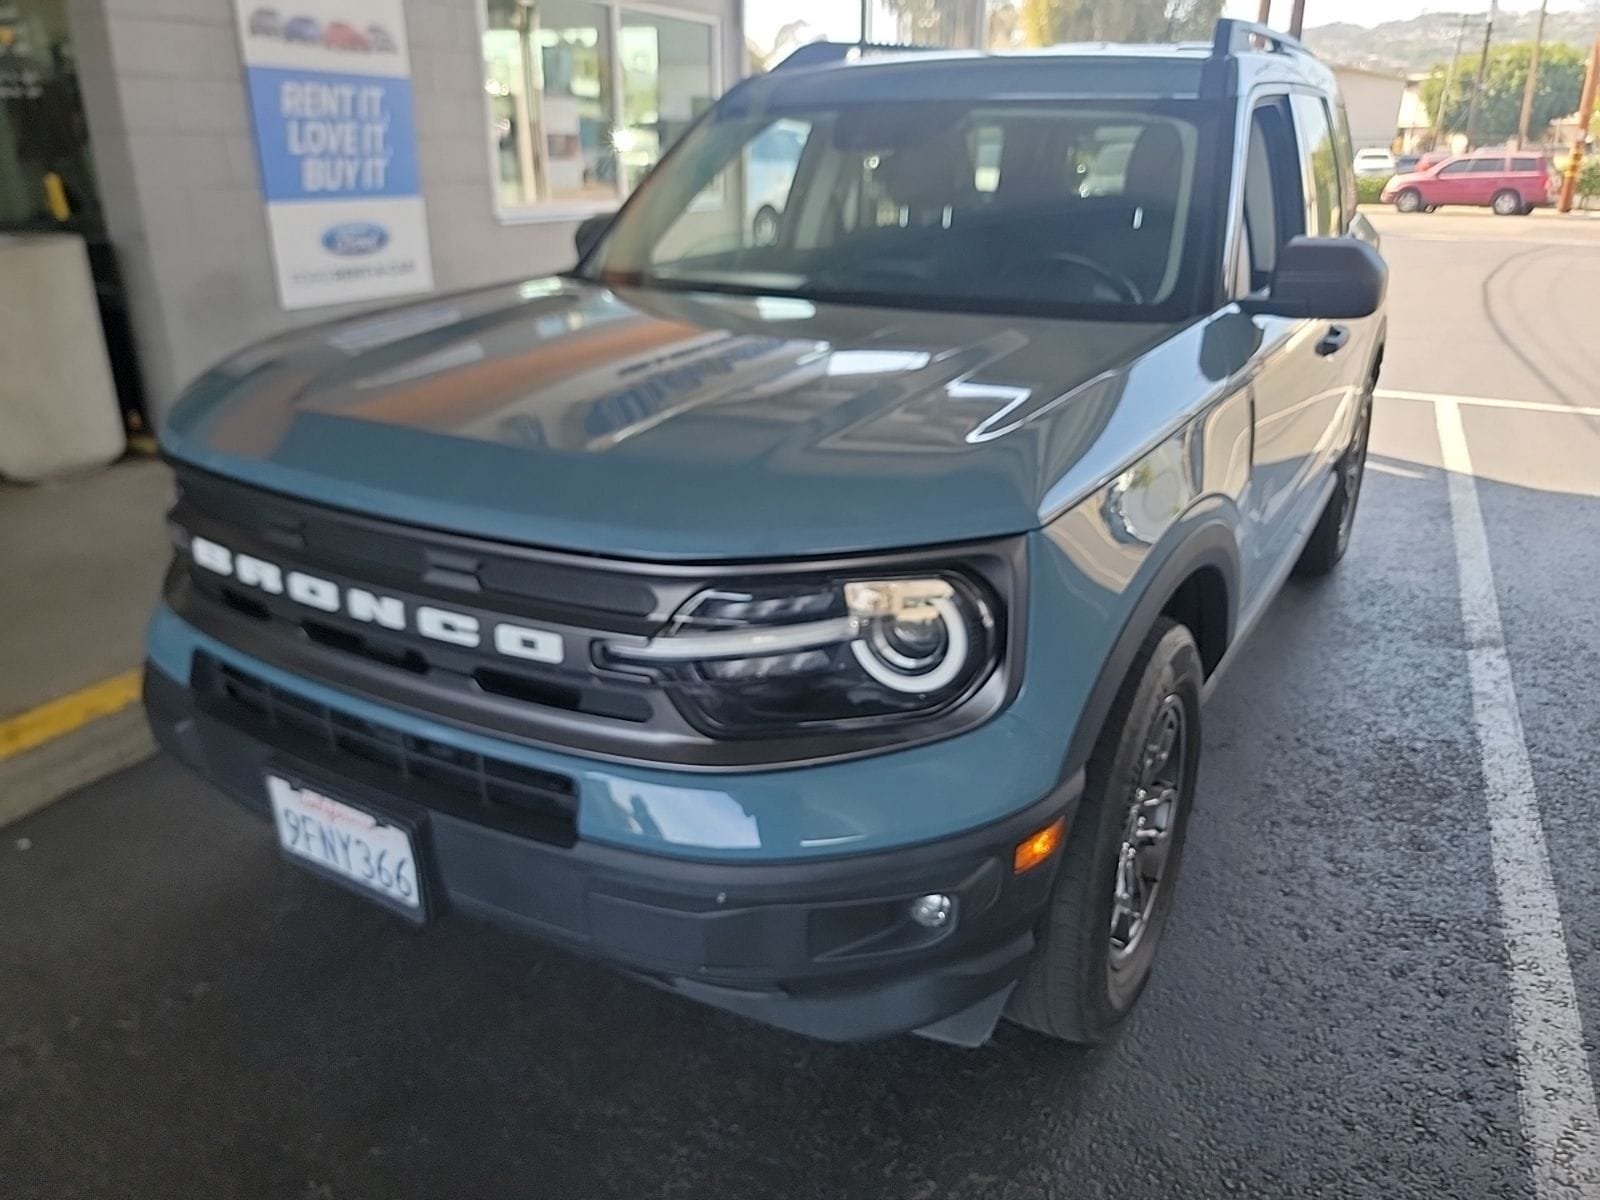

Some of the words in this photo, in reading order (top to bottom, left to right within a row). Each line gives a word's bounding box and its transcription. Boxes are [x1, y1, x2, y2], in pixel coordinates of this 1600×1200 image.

[281, 82, 354, 118] RENT
[287, 119, 357, 155] LOVE
[303, 158, 360, 192] BUY
[191, 536, 564, 664] BRONCO
[284, 808, 411, 897] 9FNY366
